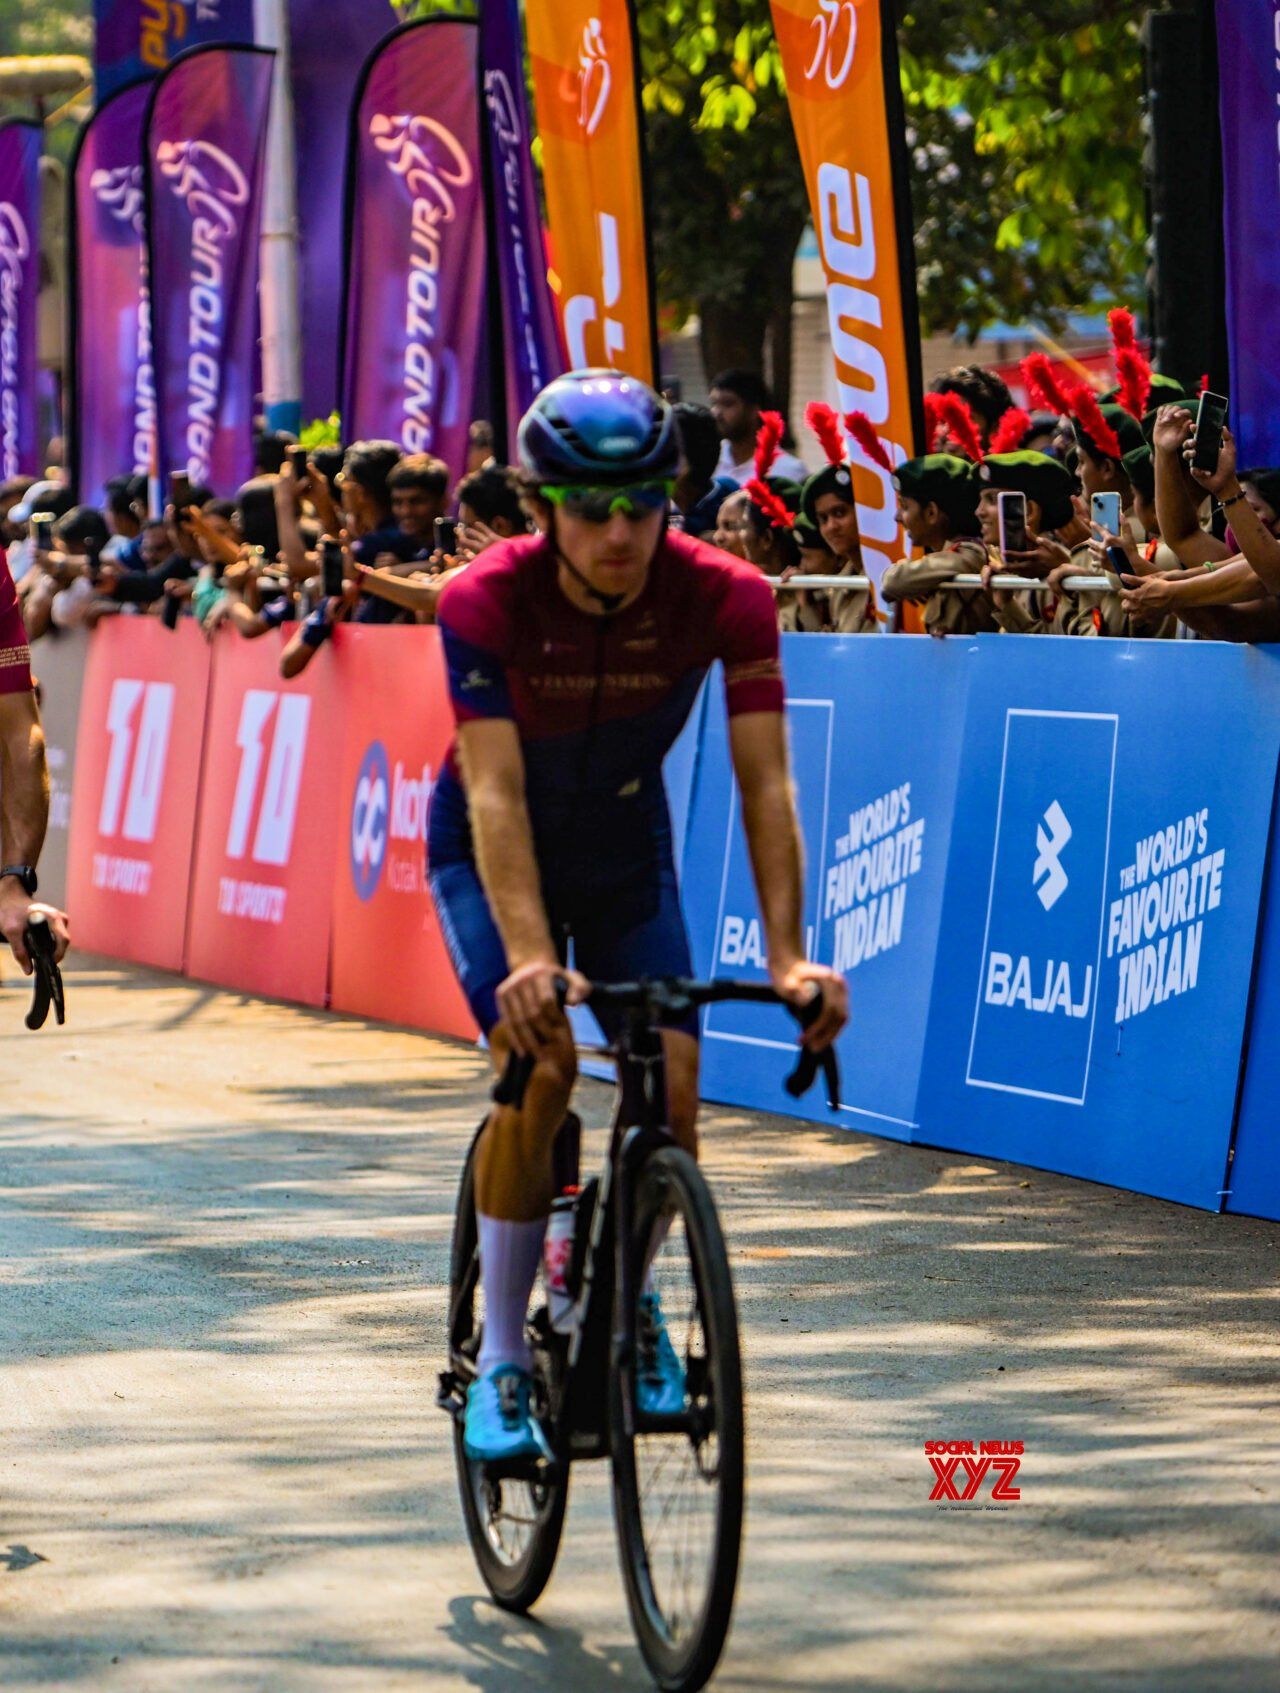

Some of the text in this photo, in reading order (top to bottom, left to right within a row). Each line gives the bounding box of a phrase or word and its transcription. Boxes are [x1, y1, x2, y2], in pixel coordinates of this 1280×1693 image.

[189, 217, 226, 348] TOUR
[402, 198, 444, 456] AND TOUR
[4, 389, 20, 477] AND
[390, 762, 437, 842] kot
[850, 782, 910, 852] WORLD'S
[824, 818, 925, 920] FAVOURITE
[1120, 807, 1209, 891] THE WORLD'S
[833, 882, 907, 974] INDIAN
[1107, 848, 1225, 958] FAVOURITE
[984, 951, 1093, 1018] BAJAJ
[1115, 920, 1204, 1024] INDIAN
